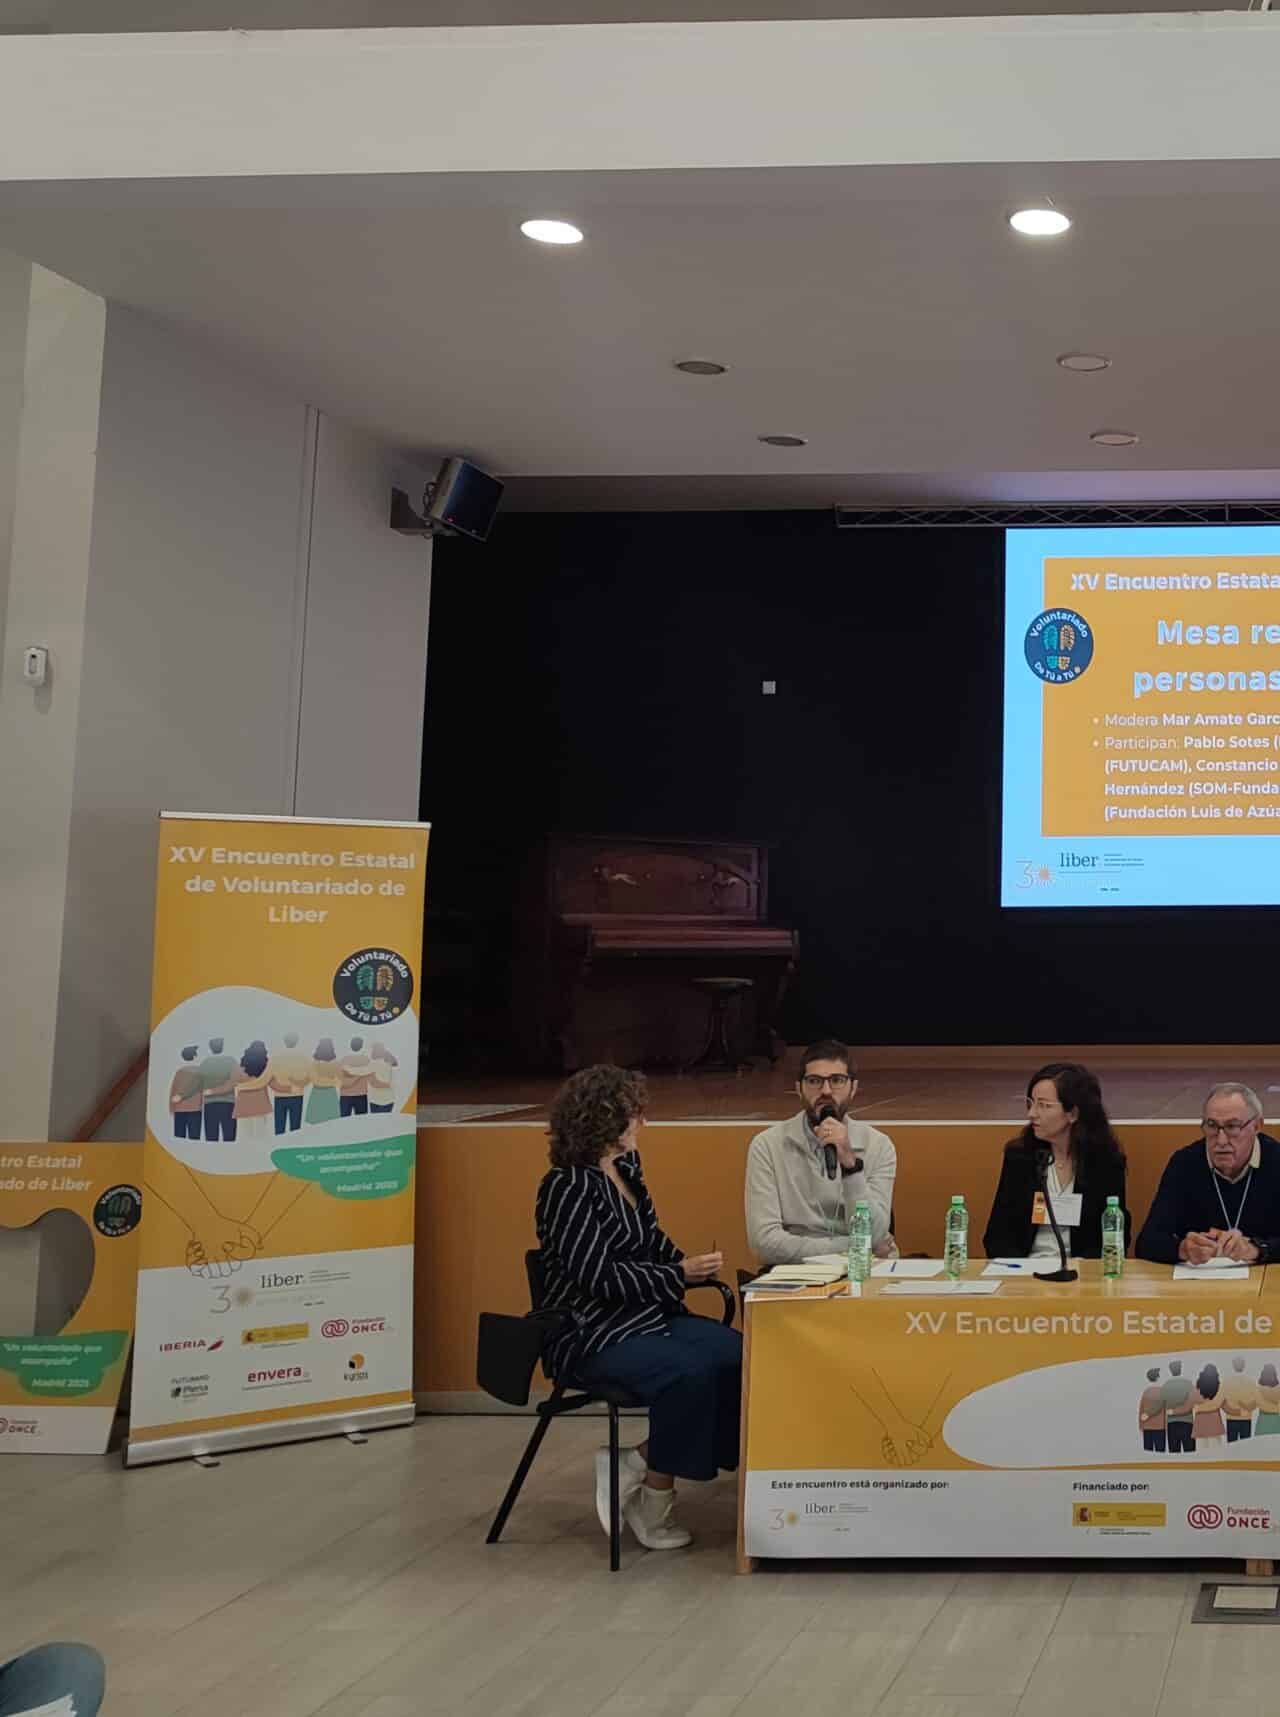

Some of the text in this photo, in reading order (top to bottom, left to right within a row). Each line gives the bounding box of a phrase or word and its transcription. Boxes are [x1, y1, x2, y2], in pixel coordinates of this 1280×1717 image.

[1071, 573, 1100, 591] XV
[1105, 573, 1212, 590] Encuentro
[1029, 611, 1088, 638] Voluntariado
[1157, 620, 1240, 645] Mesa
[1104, 713, 1158, 727] Modera
[1163, 713, 1190, 726] Mar
[1194, 713, 1243, 726] Amate
[1184, 735, 1225, 748] Pablo
[1229, 736, 1270, 748] Sotes
[1104, 759, 1192, 774] (FUTUCAM),
[1196, 759, 1278, 772] Constancio
[1104, 782, 1185, 796] Hernández
[1104, 805, 1186, 821] (Fundación
[1191, 805, 1221, 819] Luis
[1224, 805, 1243, 819] de
[168, 846, 416, 870] XV Encuentro Estatal
[1060, 852, 1099, 868] liber
[185, 875, 406, 897] de Voluntariado de
[268, 905, 329, 924] Liber
[340, 951, 408, 978] Voluntariado
[27, 1154, 82, 1168] Estatal
[28, 1177, 48, 1190] de
[51, 1177, 93, 1191] Liber
[261, 1272, 304, 1288] liber
[351, 1322, 385, 1334] ONCE
[905, 1311, 946, 1334] XV
[956, 1311, 1113, 1334] Encuentro
[1123, 1310, 1224, 1334] Estatal
[1234, 1310, 1272, 1334] de
[159, 1340, 207, 1352] IBERIA
[247, 1366, 302, 1383] envera
[771, 1480, 794, 1489] Este
[795, 1480, 848, 1489] encuentro
[850, 1479, 870, 1489] está
[872, 1480, 928, 1490] organizado
[1072, 1482, 1128, 1491] Financiado
[1227, 1506, 1270, 1515] Fundación
[1227, 1517, 1270, 1528] ONCE
